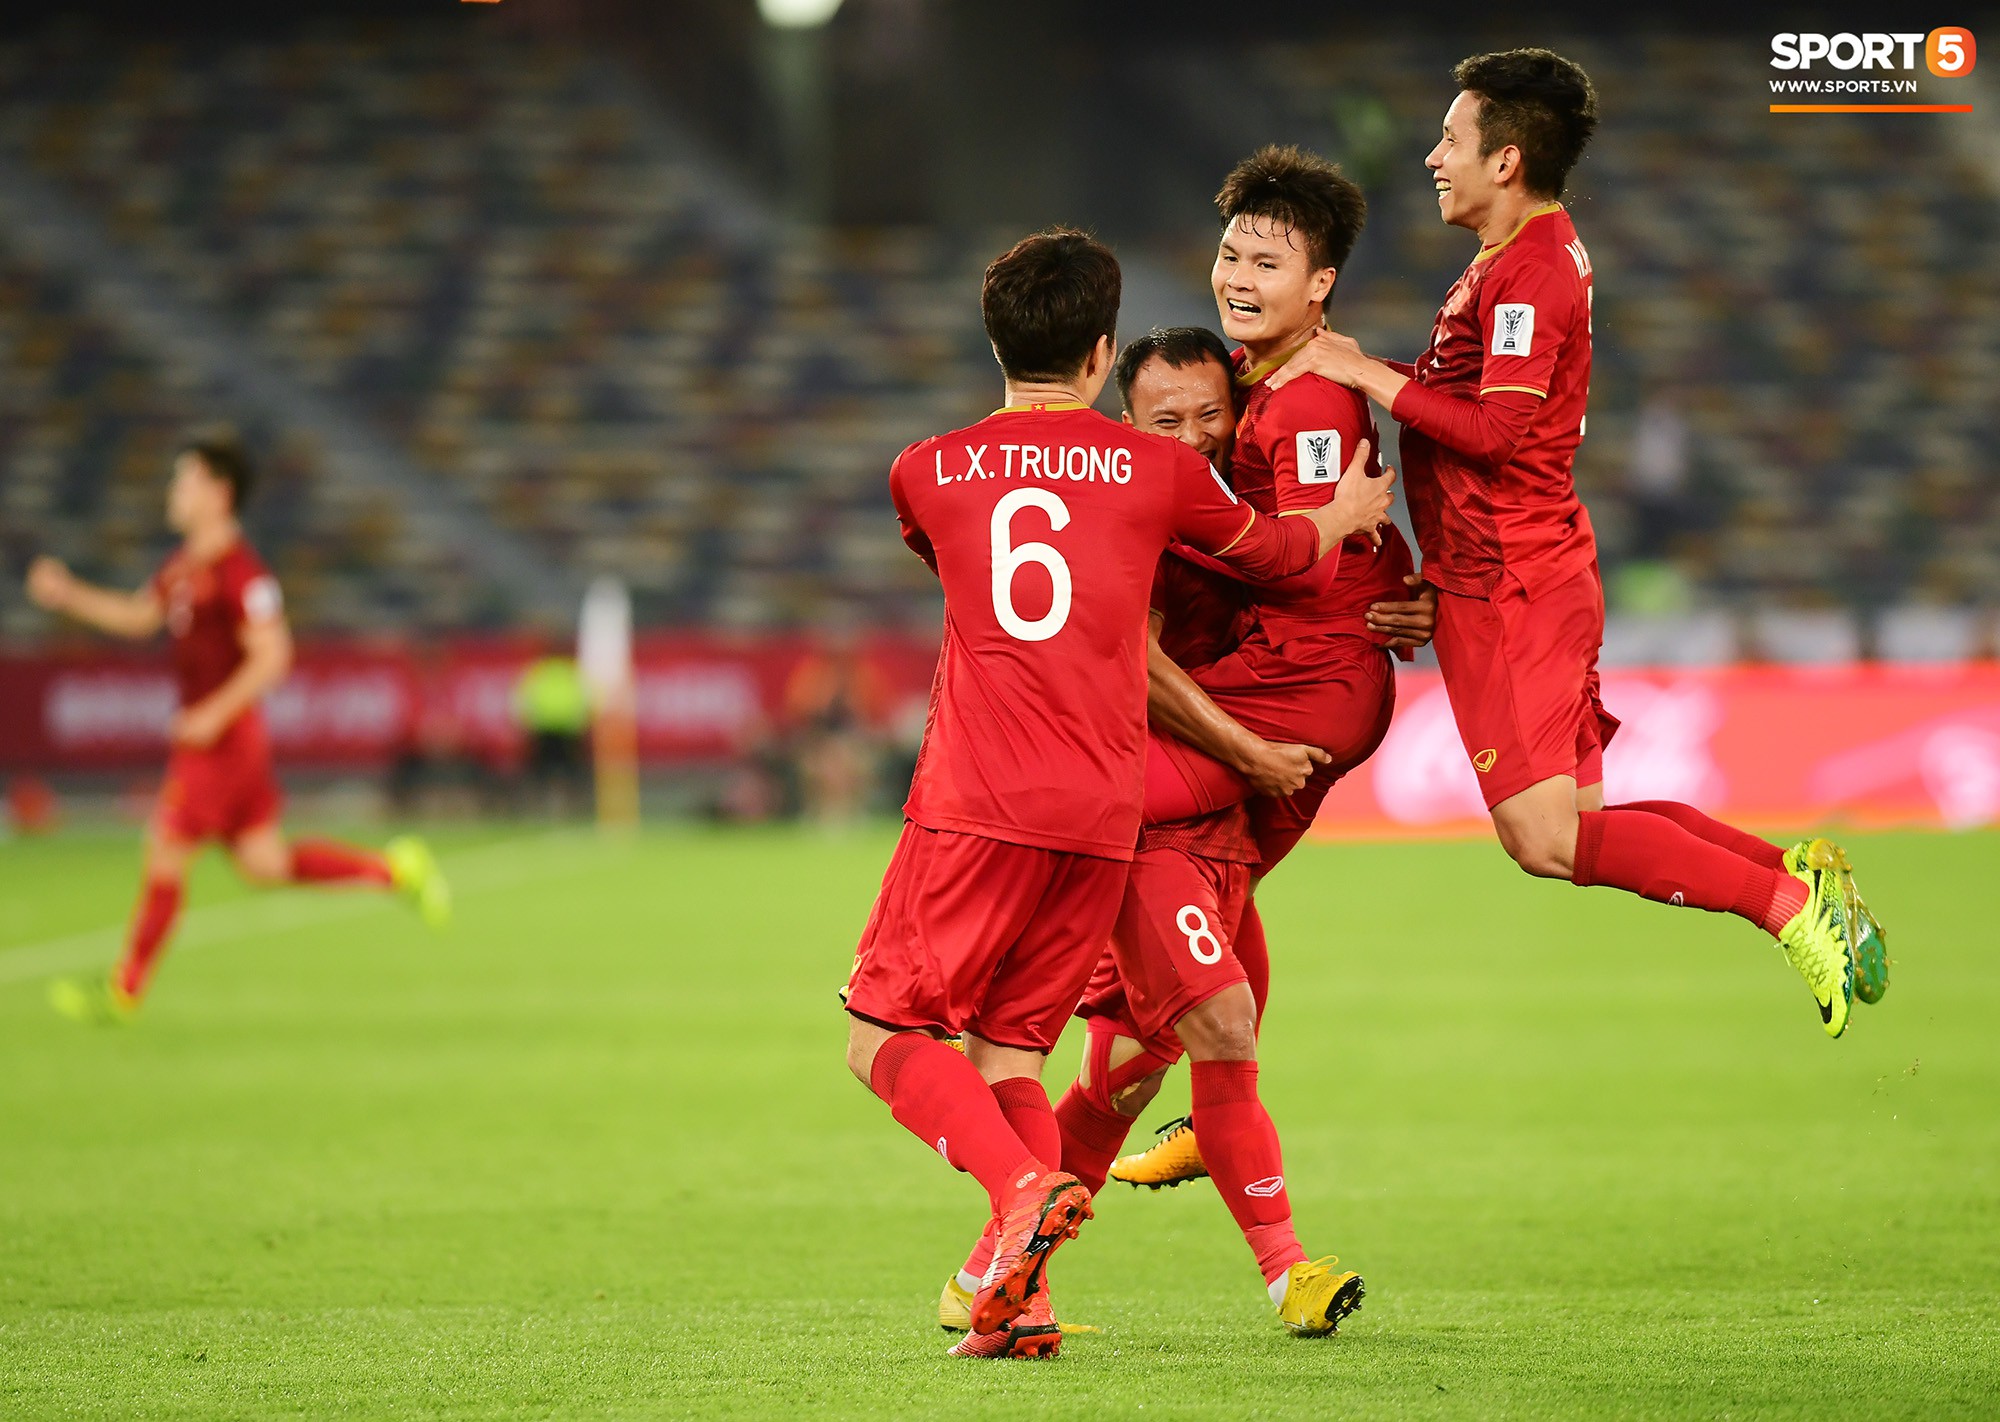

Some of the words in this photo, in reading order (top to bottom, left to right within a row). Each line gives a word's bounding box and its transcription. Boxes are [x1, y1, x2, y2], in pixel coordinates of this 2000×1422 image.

[935, 443, 1133, 486] L.X.TRUONG
[990, 487, 1073, 642] 6
[1176, 904, 1223, 965] 8
